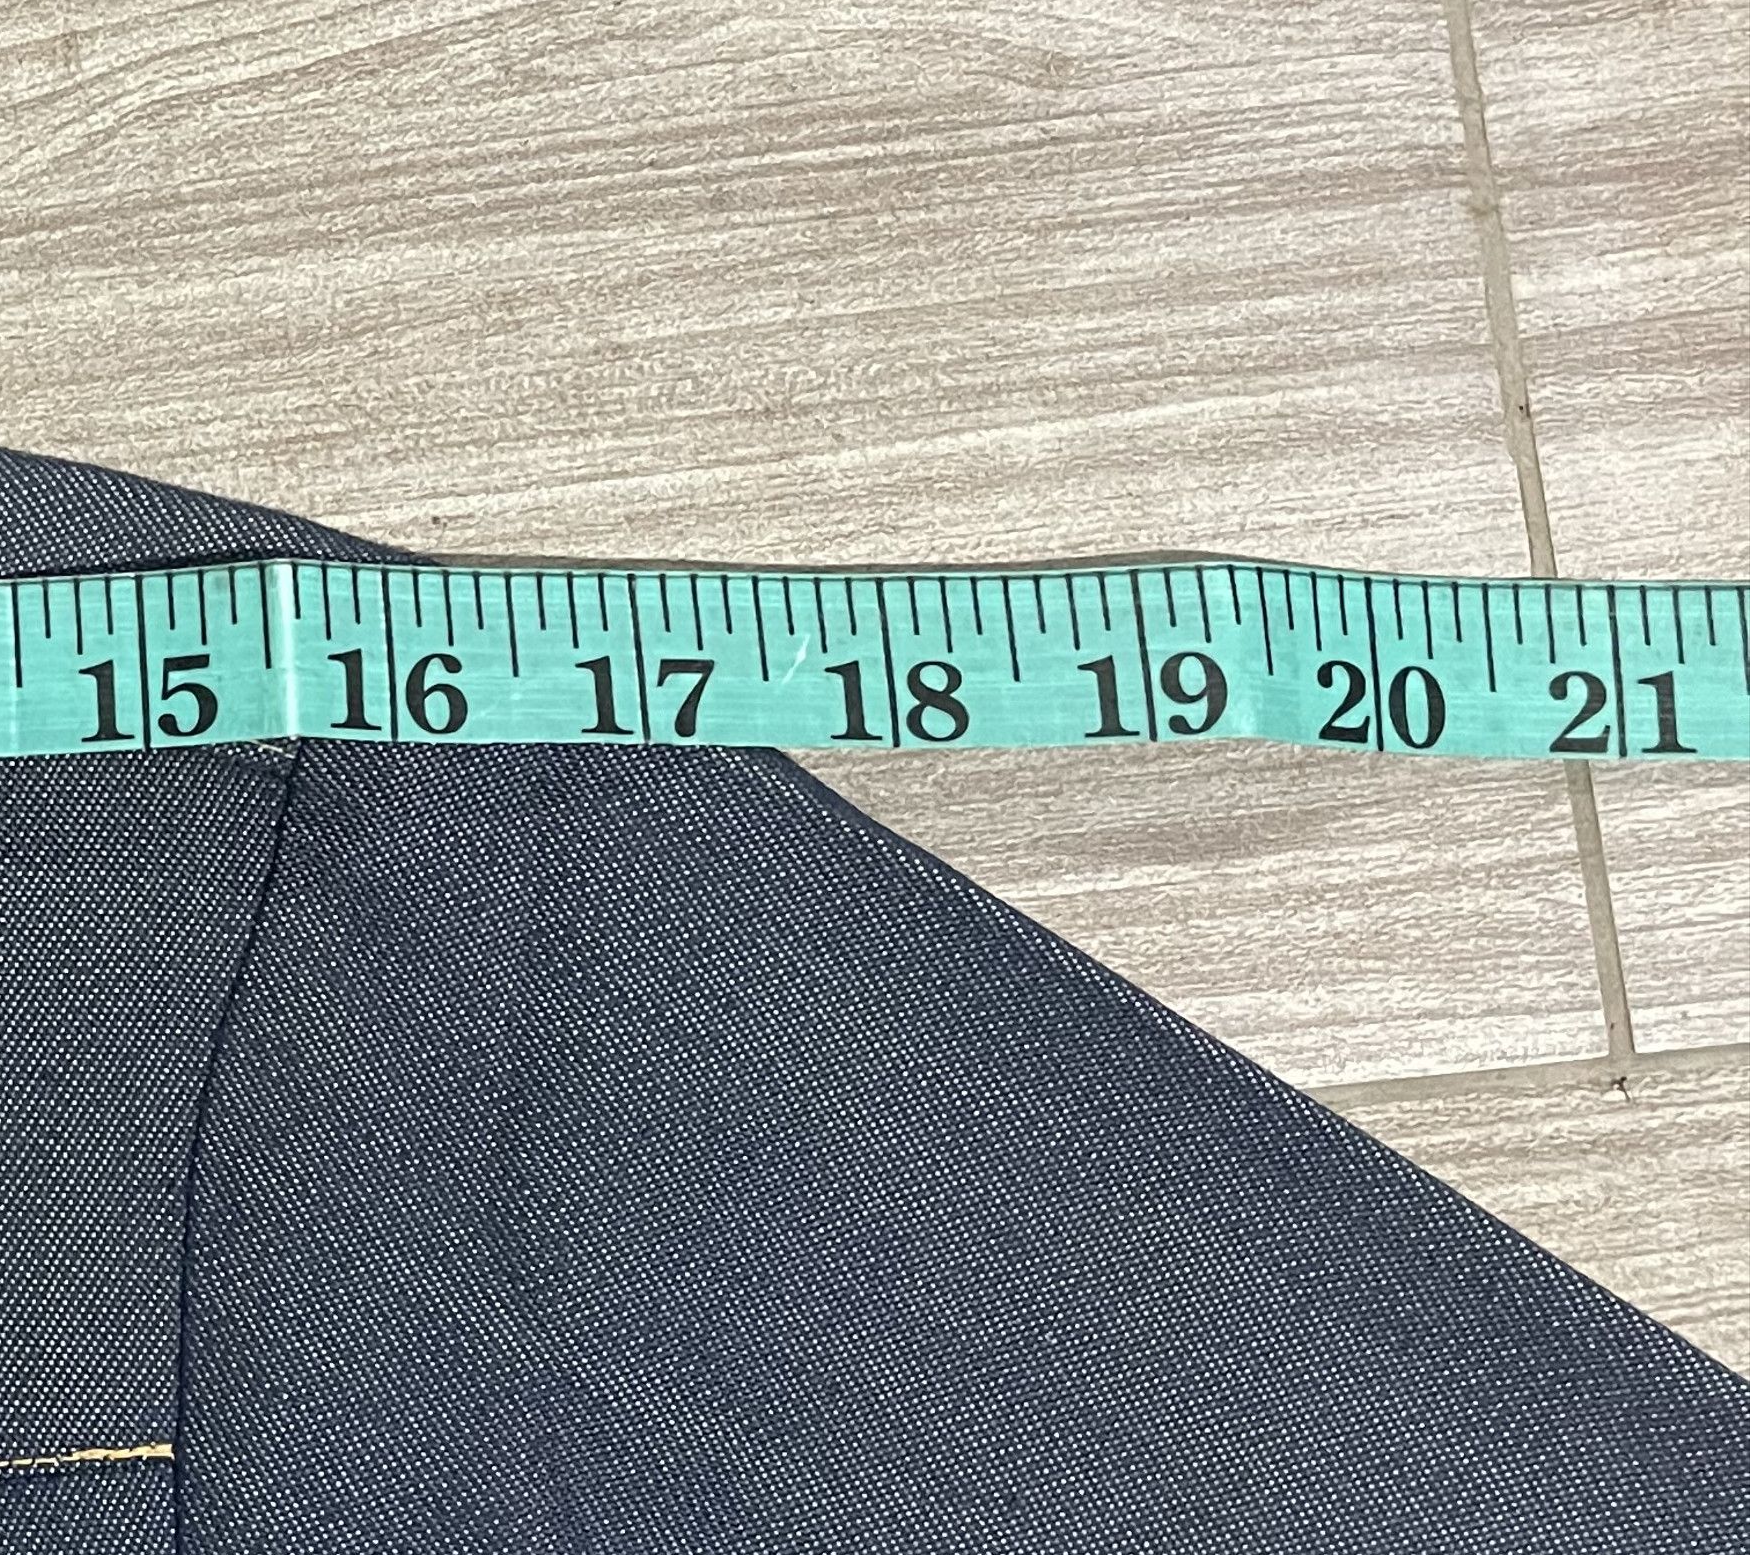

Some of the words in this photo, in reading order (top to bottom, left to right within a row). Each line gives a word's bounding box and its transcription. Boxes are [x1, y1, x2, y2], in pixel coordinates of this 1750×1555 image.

[78, 653, 219, 743] 15
[327, 648, 469, 735] 16
[575, 655, 716, 738] 17
[824, 660, 970, 742] 18
[1076, 652, 1229, 738] 19
[1316, 659, 1446, 750] 20
[1548, 670, 1698, 754] 21
